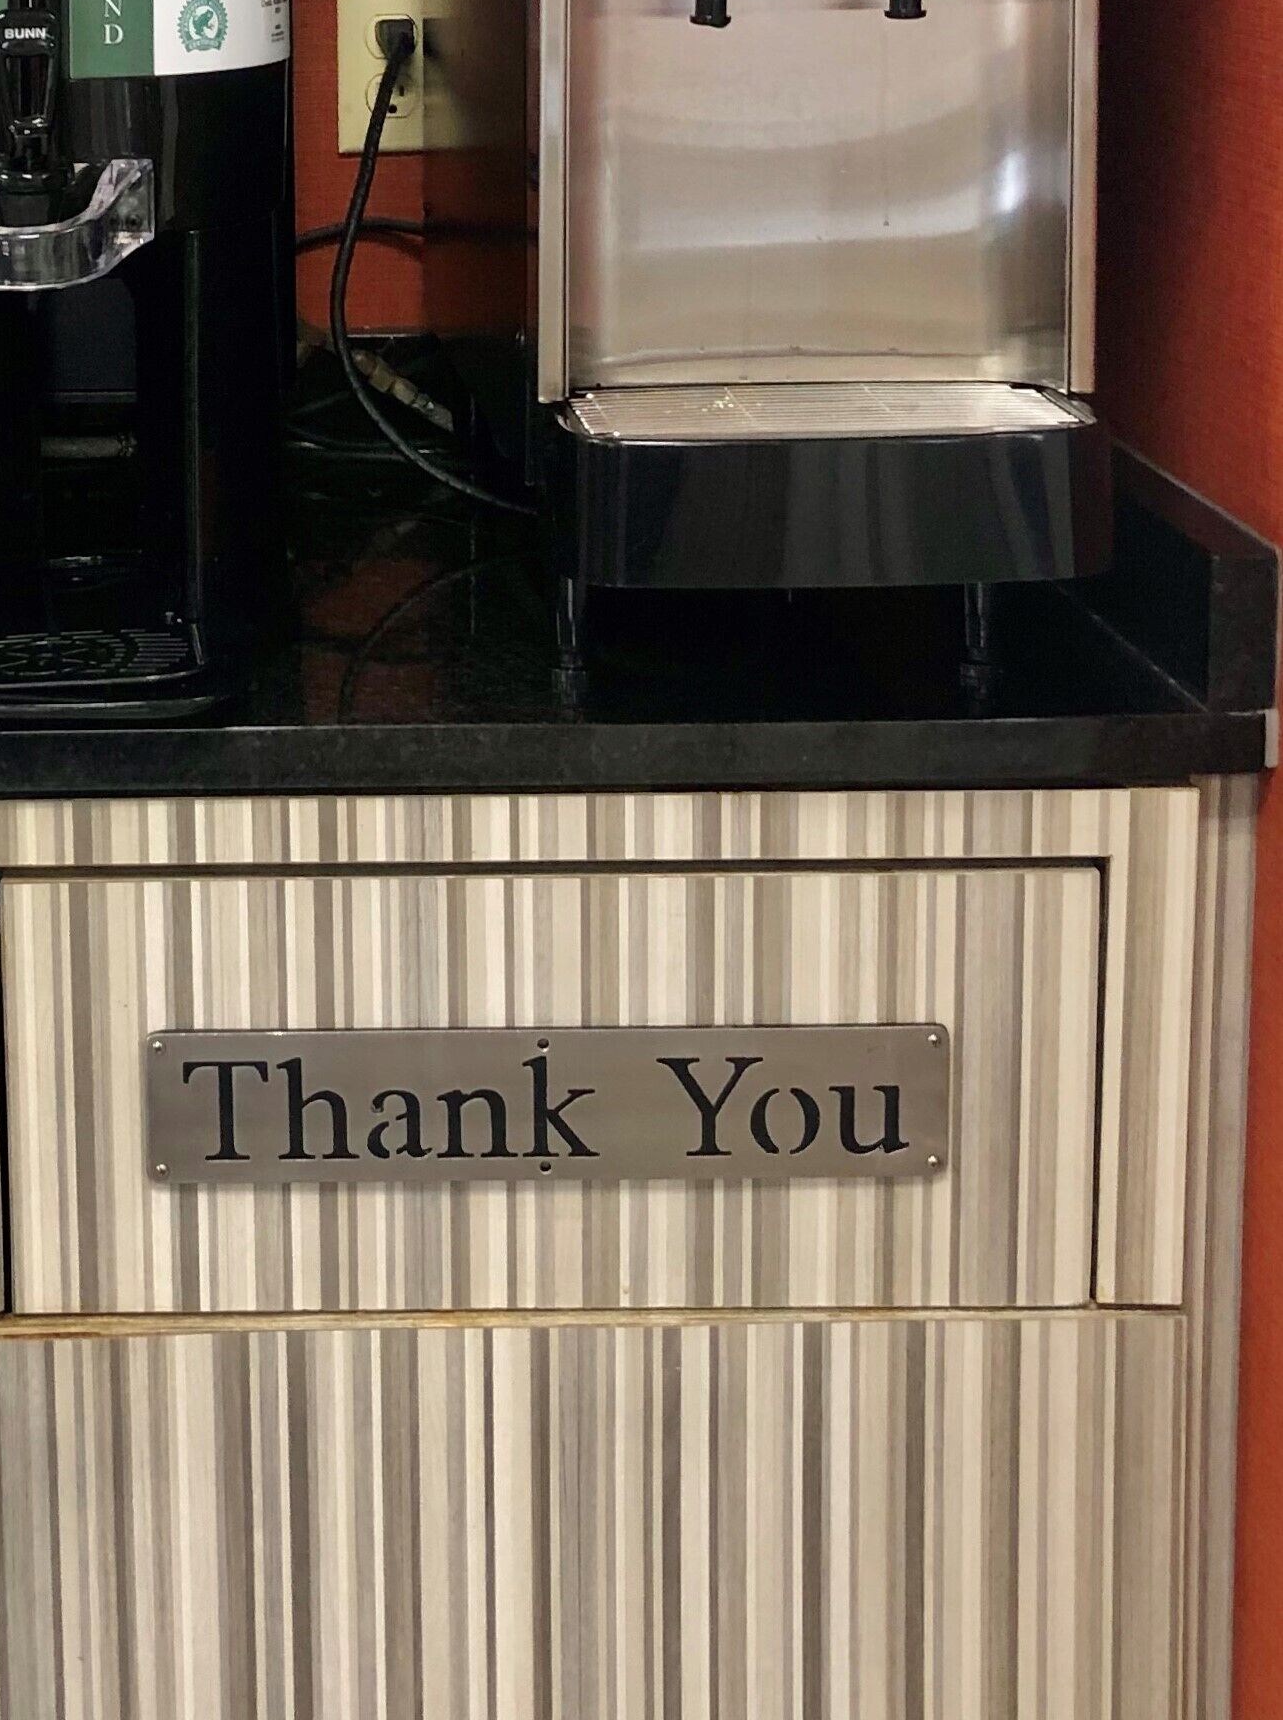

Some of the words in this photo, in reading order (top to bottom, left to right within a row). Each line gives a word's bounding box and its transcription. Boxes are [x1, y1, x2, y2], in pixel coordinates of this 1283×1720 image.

[5, 27, 46, 39] BUNN
[182, 1053, 601, 1162] Thank
[656, 1055, 912, 1158] You
